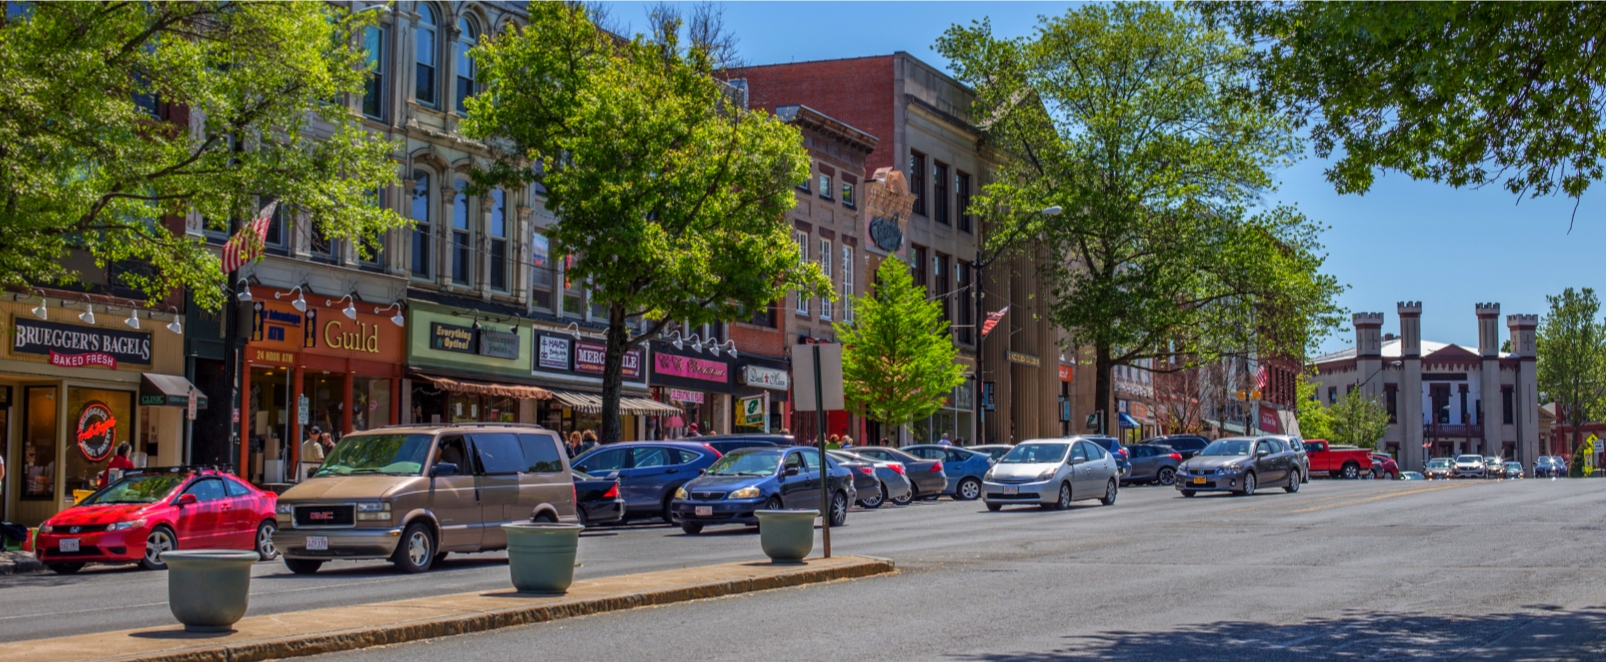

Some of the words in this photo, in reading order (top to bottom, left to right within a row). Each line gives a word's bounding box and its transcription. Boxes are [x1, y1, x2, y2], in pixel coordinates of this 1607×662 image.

[324, 320, 379, 353] Guild
[436, 325, 472, 341] Everything
[15, 324, 100, 351] BRUEGGER'S
[102, 335, 151, 360] BAGELS
[443, 337, 469, 350] Optical
[548, 339, 568, 350] HAVEN
[53, 354, 84, 366] BAKED
[86, 355, 114, 367] FRESH
[256, 350, 265, 360] 24
[265, 351, 281, 362] HOUR
[281, 353, 294, 363] ATM
[578, 348, 637, 369] MERCILE
[141, 395, 164, 404] CLINIC
[309, 511, 334, 520] GMC
